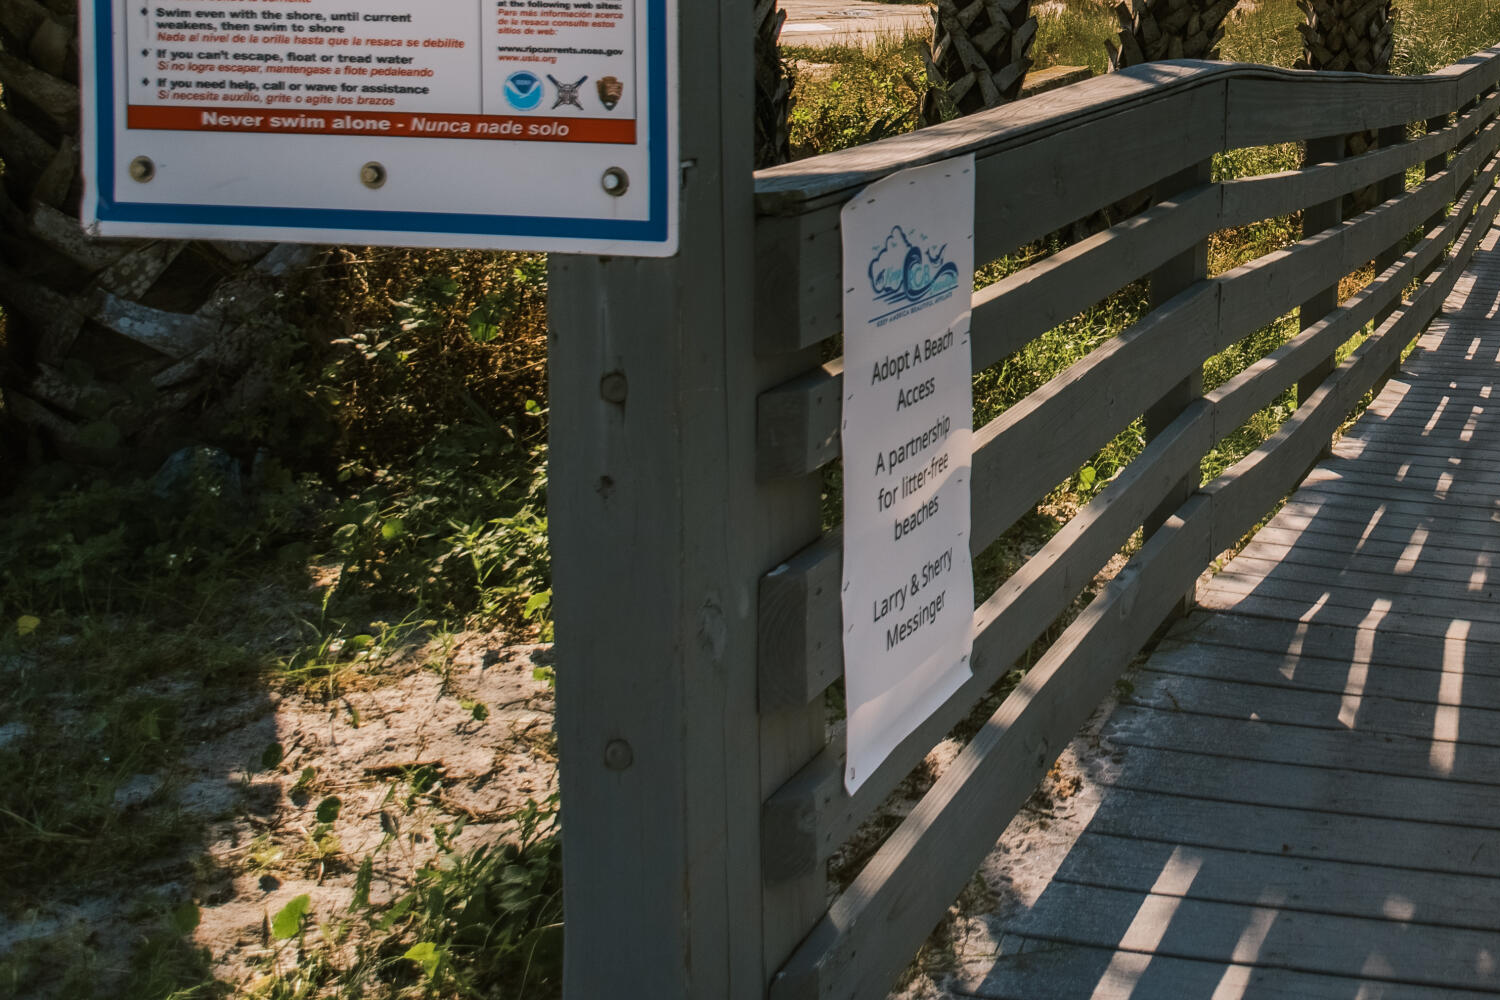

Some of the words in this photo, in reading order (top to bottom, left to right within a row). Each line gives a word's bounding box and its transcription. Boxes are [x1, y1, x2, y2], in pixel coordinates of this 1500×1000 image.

[200, 112, 264, 126] Never
[268, 114, 326, 128] swim
[330, 116, 392, 130] alone
[410, 118, 471, 132] Nunca
[476, 121, 523, 134] nade
[528, 122, 569, 135] solo
[872, 350, 910, 386] Adopt
[913, 344, 922, 366] A
[924, 328, 953, 360] Beach
[896, 377, 935, 412] Access
[875, 452, 885, 476] A
[889, 415, 950, 475] partnership
[878, 488, 898, 512] for
[902, 453, 948, 499] litter-free
[895, 496, 938, 541] beaches
[873, 584, 907, 622] Larry
[911, 573, 919, 596] &
[922, 547, 952, 588] Sherry
[887, 590, 945, 652] Messinger
